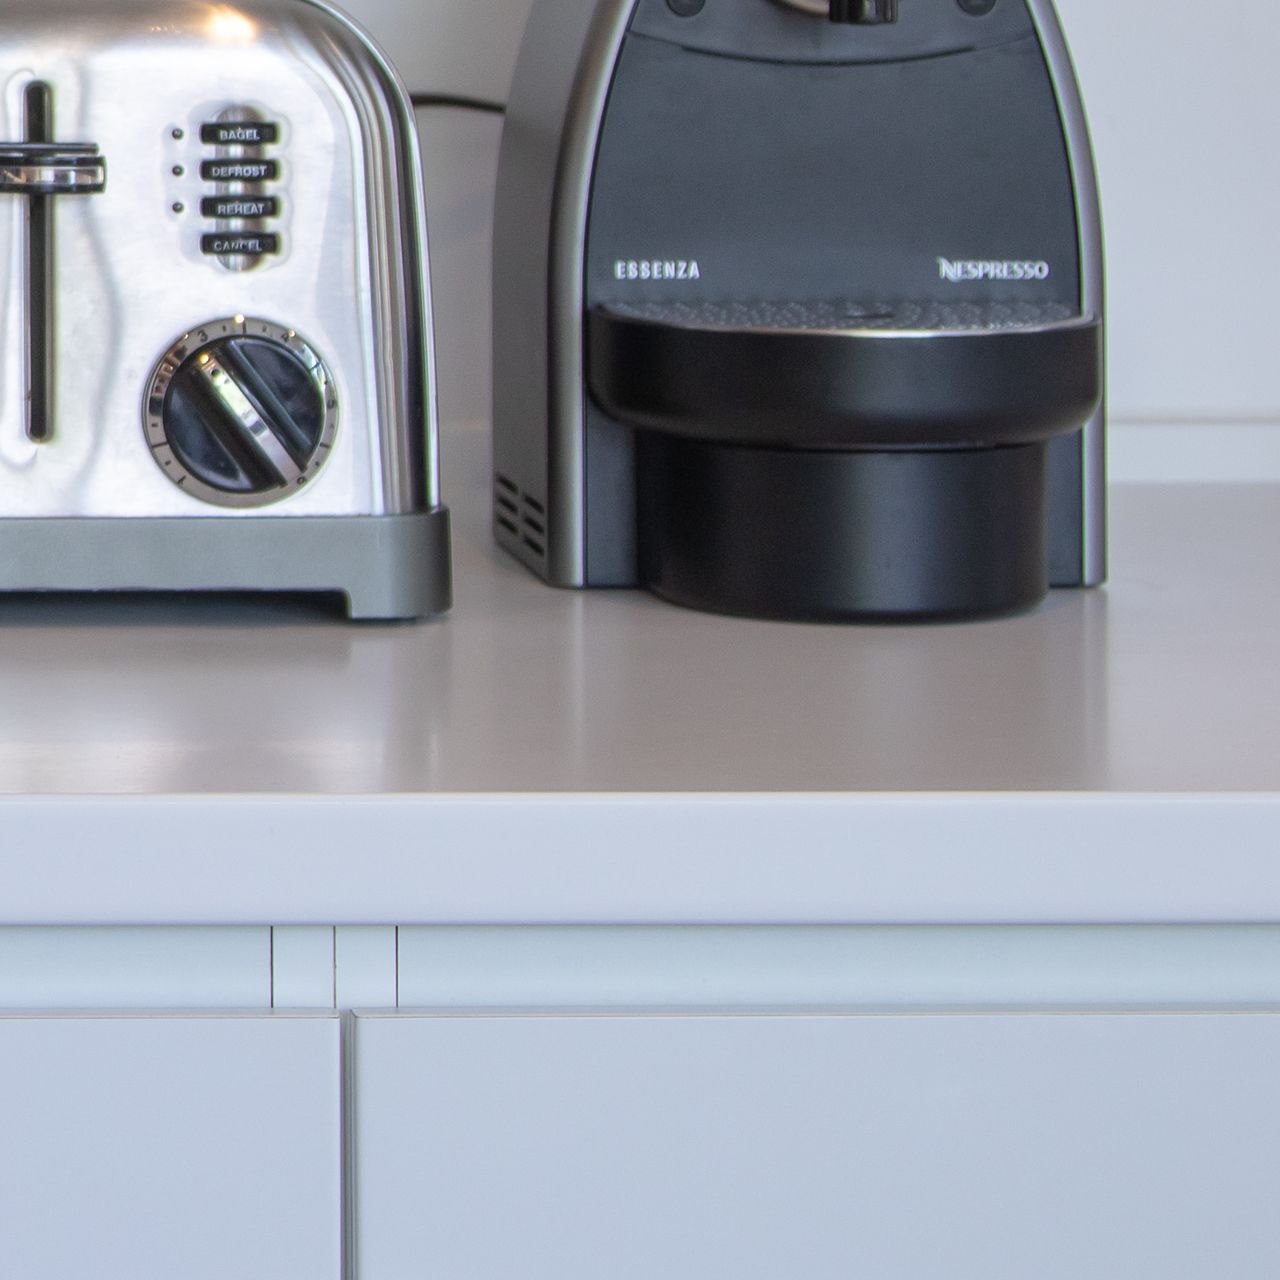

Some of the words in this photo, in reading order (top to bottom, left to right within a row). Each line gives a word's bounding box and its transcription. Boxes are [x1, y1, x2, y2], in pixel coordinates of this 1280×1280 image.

[219, 128, 261, 141] BAGEL
[211, 165, 267, 178] DEFROST
[216, 202, 265, 216] REHEAT
[213, 238, 263, 252] CANCEL
[613, 259, 701, 280] ESSENZA
[937, 255, 1050, 283] NESPRESSO
[196, 329, 209, 343] 3
